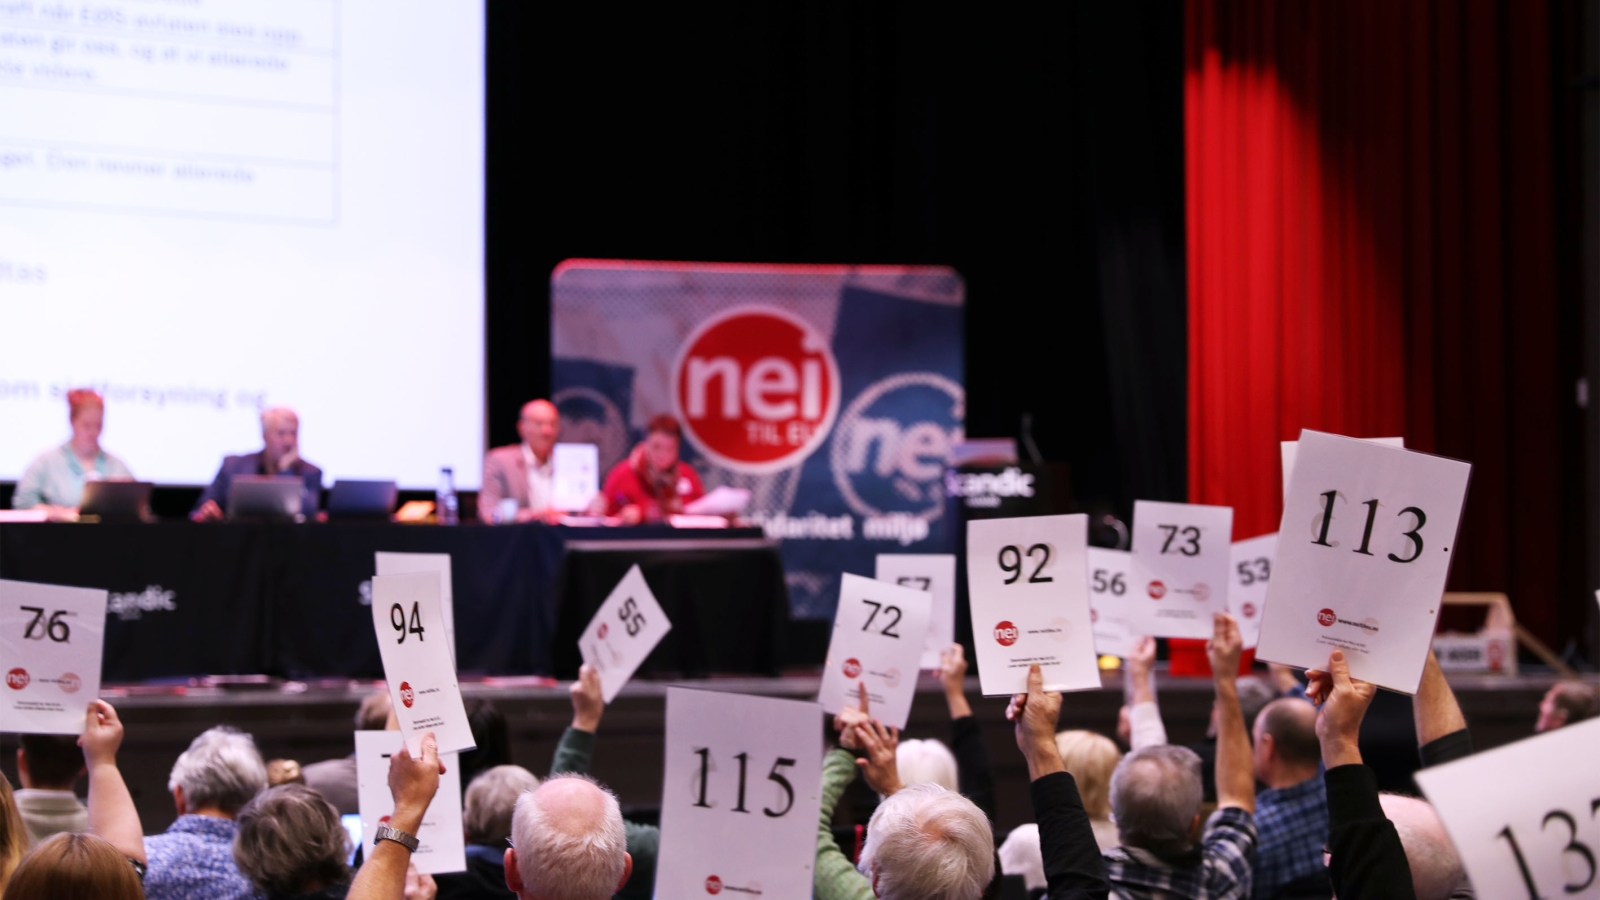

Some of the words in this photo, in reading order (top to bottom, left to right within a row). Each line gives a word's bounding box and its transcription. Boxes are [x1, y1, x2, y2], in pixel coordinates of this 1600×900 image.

[686, 325, 824, 421] nei
[744, 422, 783, 446] TIL
[843, 404, 964, 480] ne
[1159, 525, 1201, 557] 73
[1311, 489, 1428, 565] 113
[998, 542, 1055, 586] 92
[1091, 569, 1127, 597] 56
[1236, 558, 1272, 586] 53
[20, 605, 70, 643] 76
[390, 601, 425, 645] 94
[617, 597, 647, 638] 55
[862, 599, 902, 639] 72
[994, 624, 1018, 640] nei
[692, 746, 797, 819] 115
[1495, 795, 1600, 900] 13
